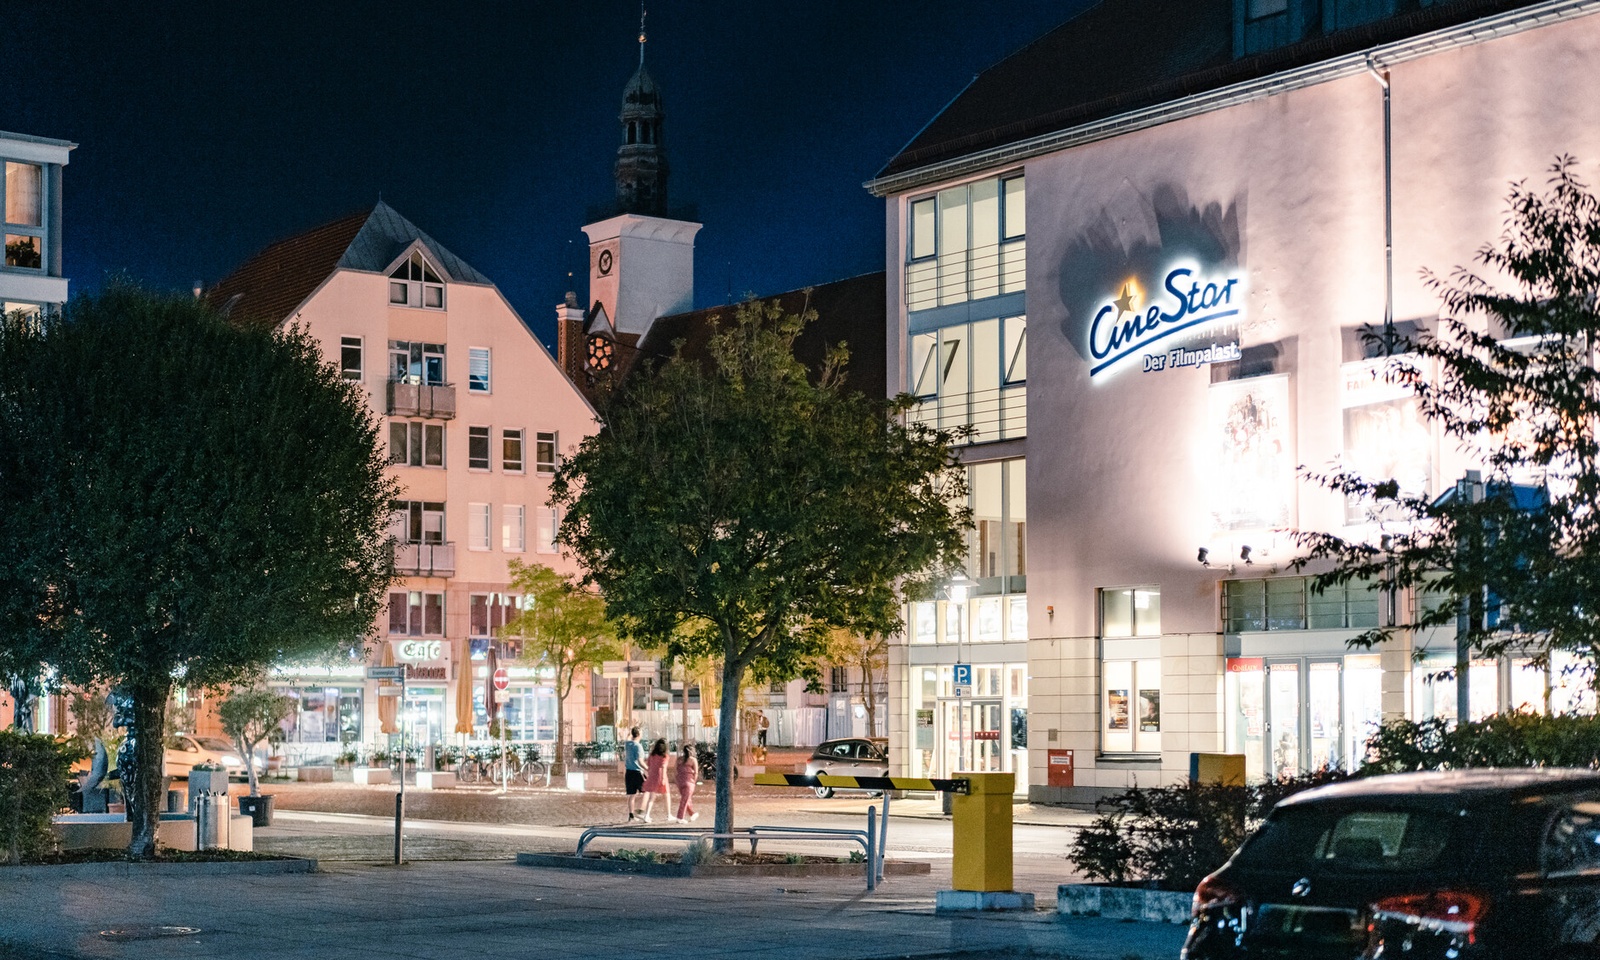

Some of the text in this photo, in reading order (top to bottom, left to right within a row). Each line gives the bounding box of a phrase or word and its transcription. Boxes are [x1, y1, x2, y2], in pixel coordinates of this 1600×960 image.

[1089, 268, 1239, 360] CineStar
[1143, 354, 1166, 373] Der
[957, 667, 968, 684] P
